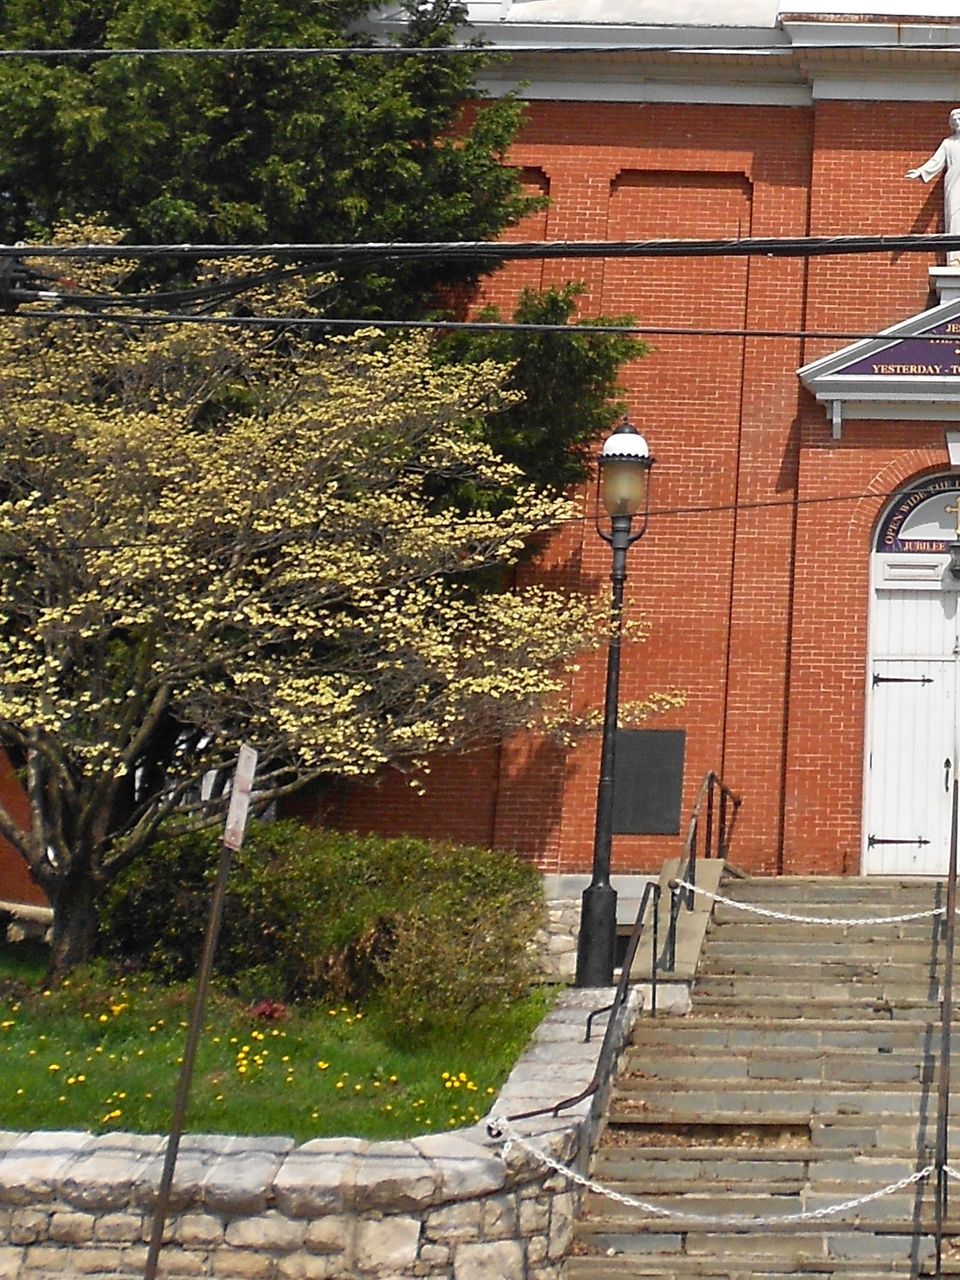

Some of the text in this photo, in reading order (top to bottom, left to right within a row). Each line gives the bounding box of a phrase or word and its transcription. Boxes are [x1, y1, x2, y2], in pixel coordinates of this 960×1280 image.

[872, 364, 943, 375] YESTERDAY
[885, 513, 904, 545] OPEN
[900, 490, 928, 513] WIDE
[903, 541, 946, 552] JUBILEE
